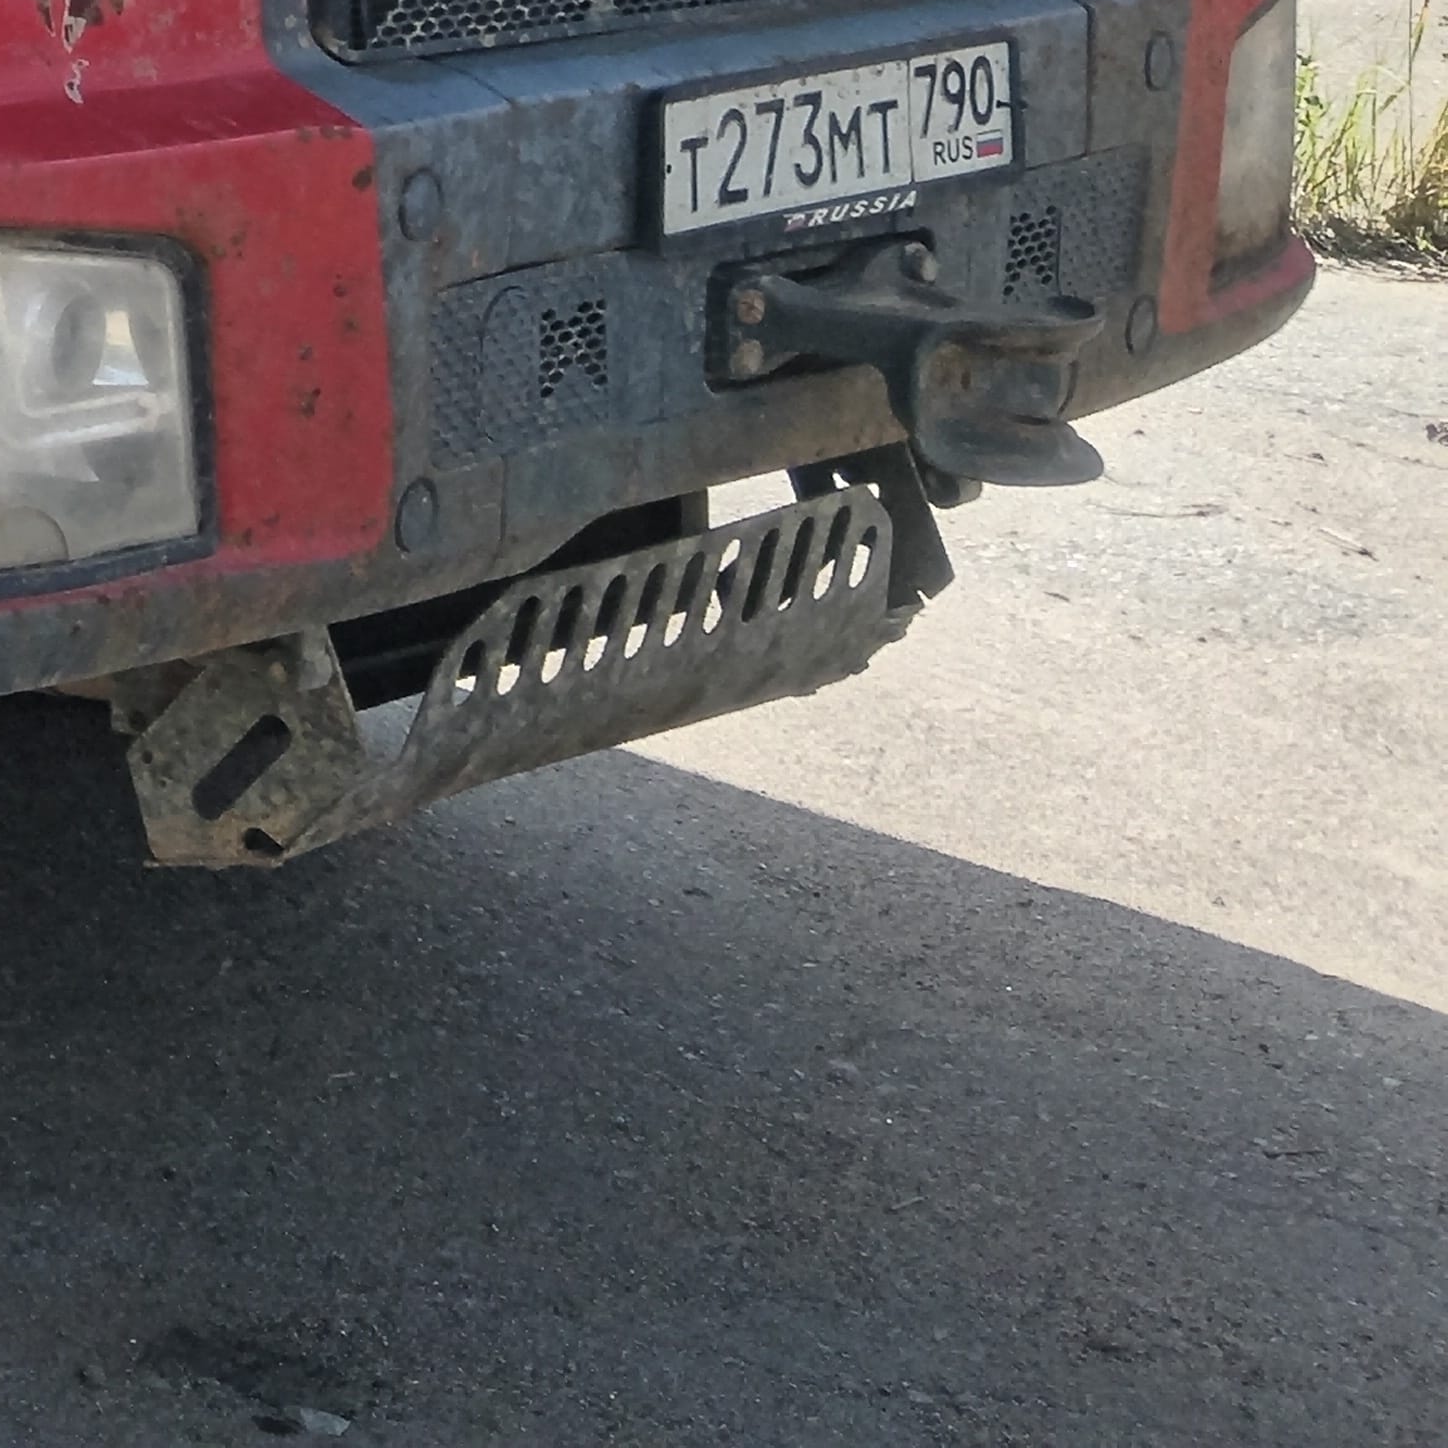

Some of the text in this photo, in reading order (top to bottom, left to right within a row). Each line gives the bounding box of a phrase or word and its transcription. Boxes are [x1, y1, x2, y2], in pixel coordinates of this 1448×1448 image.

[914, 55, 996, 139] 790
[932, 135, 974, 166] RUS
[807, 190, 917, 228] RUSSIA
